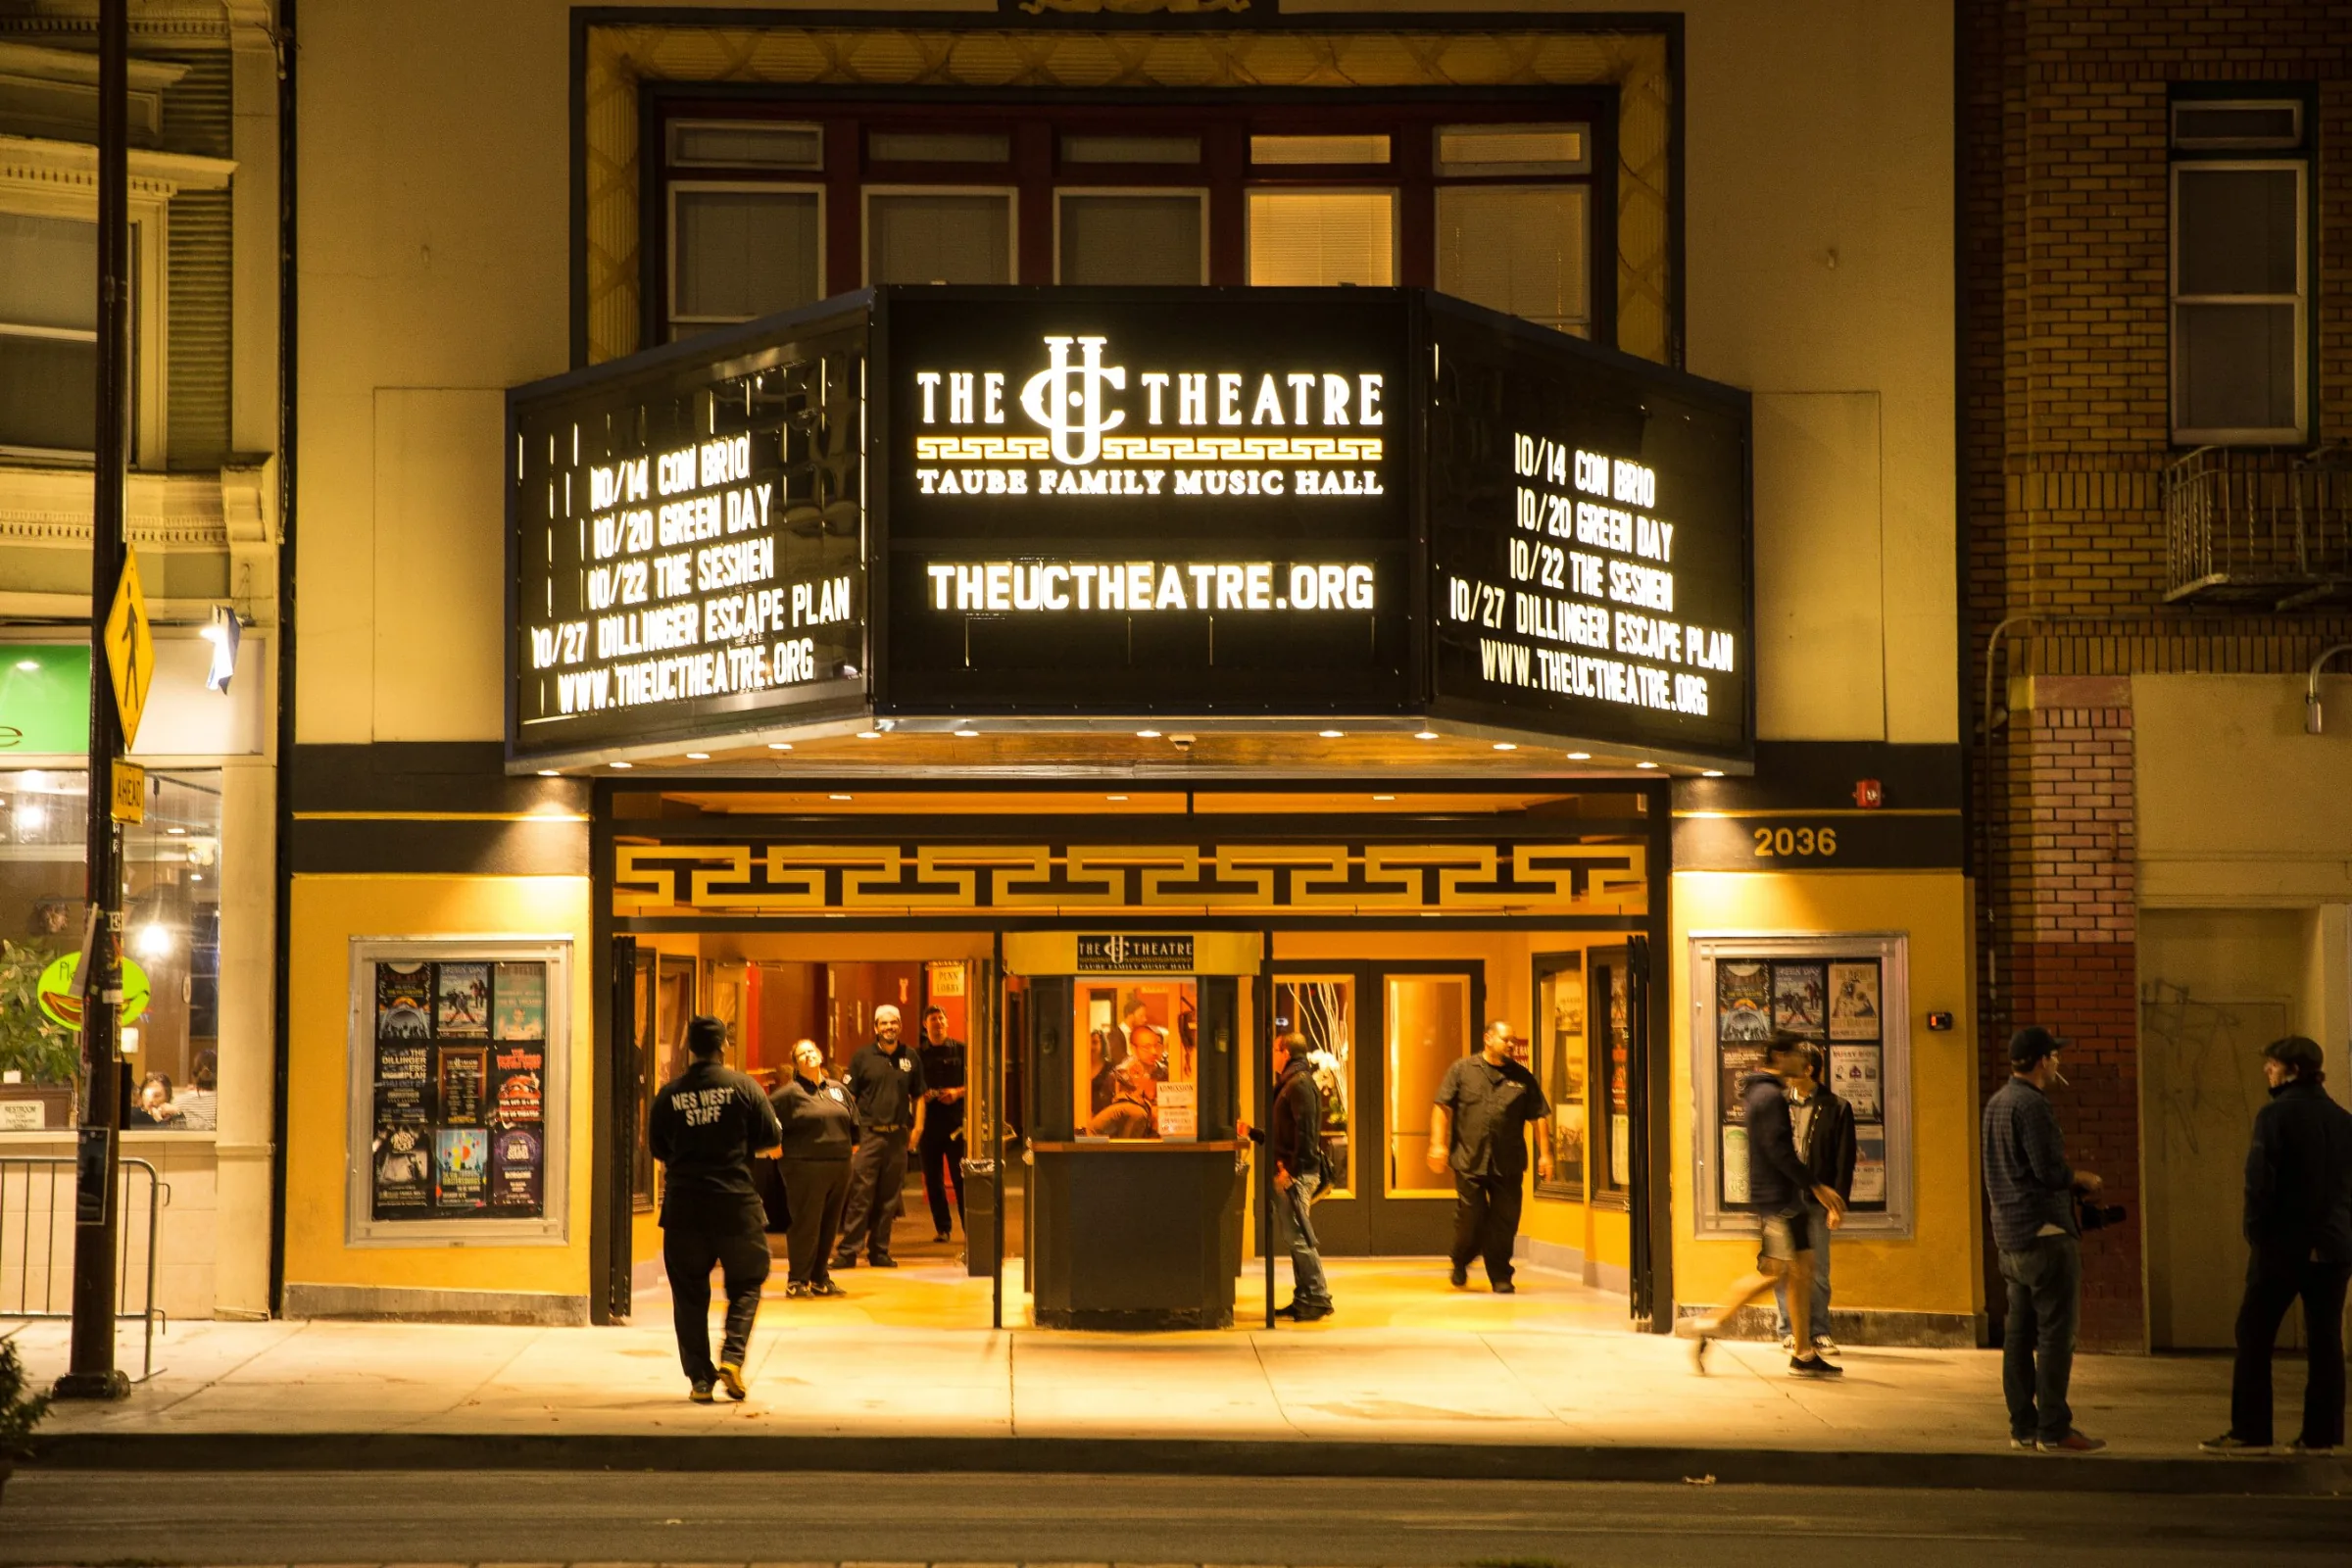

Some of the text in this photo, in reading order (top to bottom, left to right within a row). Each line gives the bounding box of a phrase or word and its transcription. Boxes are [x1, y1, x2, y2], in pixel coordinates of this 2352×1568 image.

[917, 372, 1004, 424] THE
[1141, 372, 1384, 425] THEATRE
[590, 435, 750, 512] 10/14 CON BRIO
[916, 468, 1384, 495] TAUBE FAMILY MUSIC HALL
[1515, 432, 1655, 508] 10/14 CON BRIO
[593, 483, 772, 559] 10/20 GREEN DAY
[1517, 486, 1674, 562] 10/20 GREEN DAY
[588, 536, 774, 610] 10/22 THE SESHEN
[928, 564, 1375, 612] THEUCTHEATRE.ORG
[1510, 538, 1674, 612] 10/22 THE SESHEN
[532, 576, 851, 668] 10/27 DILLINGER ESCAPE PLAN
[1450, 576, 1734, 672] 10/27 DILLINGER ESCAPE PLAN
[558, 637, 814, 714] WWW.THEUCTHEATRE.ORG
[1480, 638, 1708, 715] WWW.THEUCTHEATRE.ORG
[117, 777, 141, 807] AHEAD
[1753, 827, 1837, 857] 2036
[1079, 942, 1102, 956] THE
[1133, 942, 1193, 956] THEATRE
[937, 983, 959, 993] LOBBY
[671, 1092, 698, 1110] NES
[686, 1105, 721, 1127] STAFF
